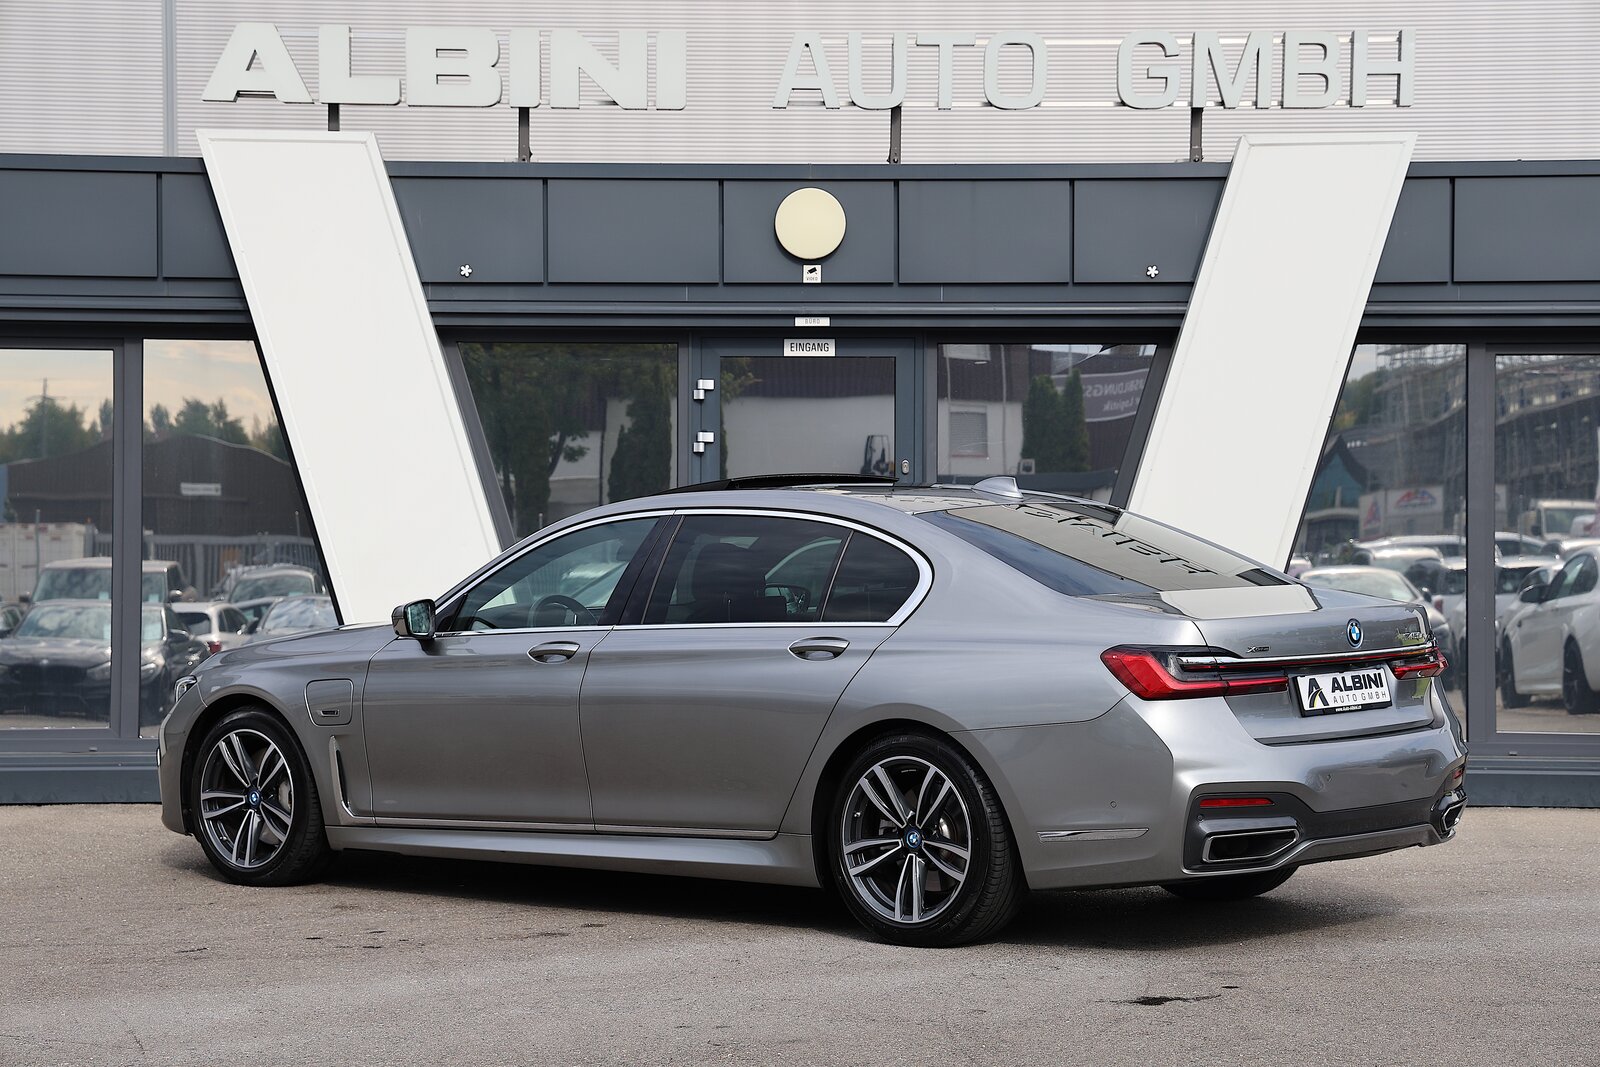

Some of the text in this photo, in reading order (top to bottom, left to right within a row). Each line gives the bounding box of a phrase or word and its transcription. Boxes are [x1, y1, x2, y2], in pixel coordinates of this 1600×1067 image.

[202, 22, 1416, 111] ALBINI AUTO GMBH
[790, 342, 830, 352] EINGANG
[1332, 672, 1384, 693] ALBINI
[1333, 691, 1387, 704] AUTO GMBH
